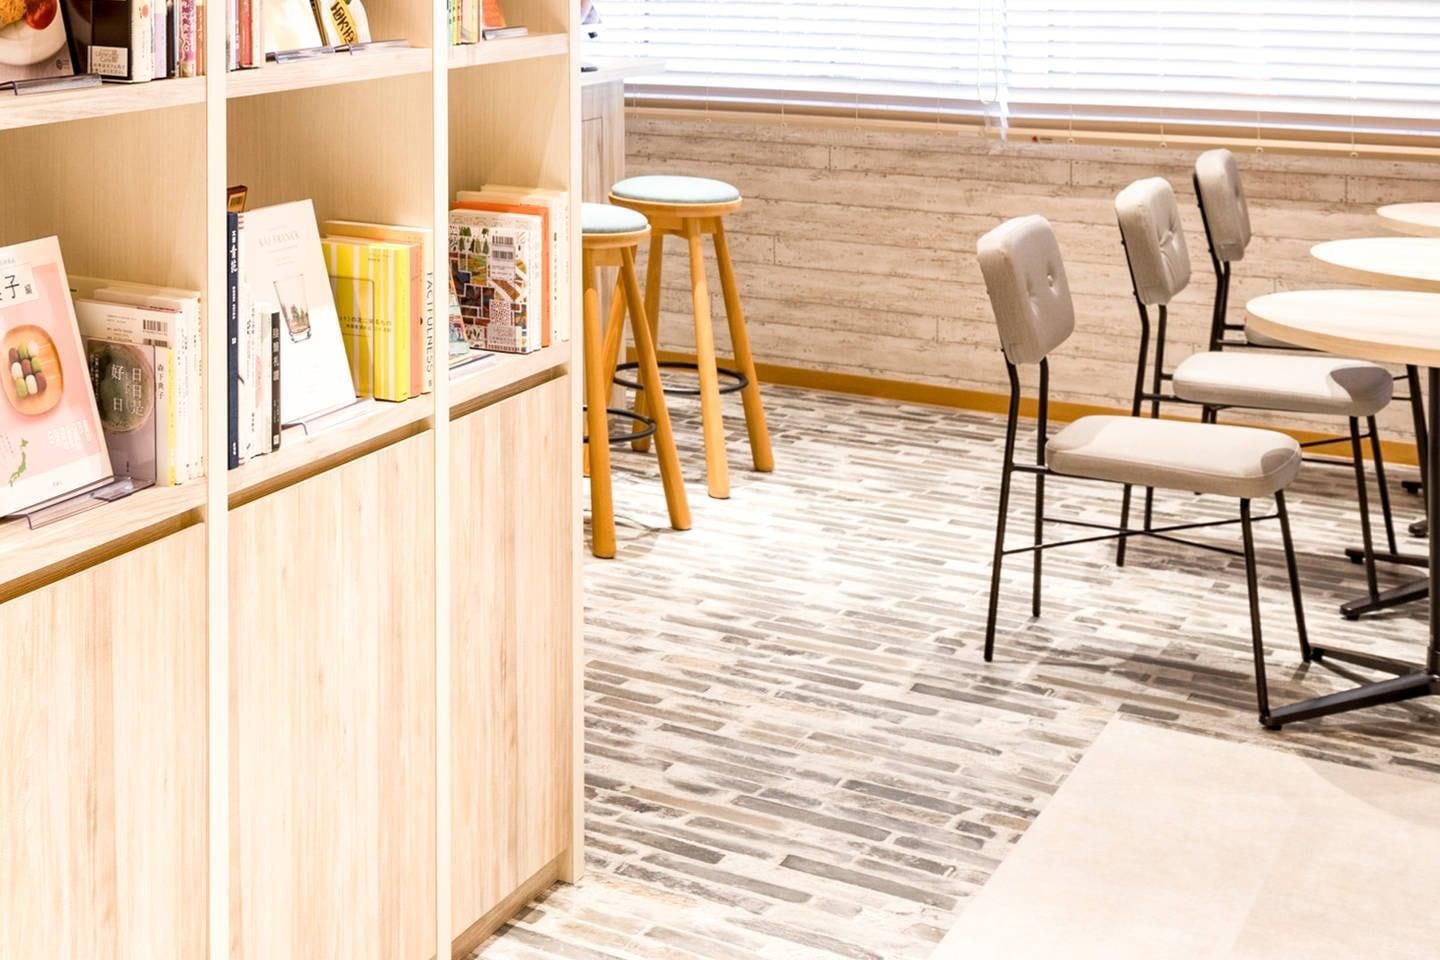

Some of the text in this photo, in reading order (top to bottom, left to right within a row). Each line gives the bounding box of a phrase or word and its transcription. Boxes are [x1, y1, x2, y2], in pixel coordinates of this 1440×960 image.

[111, 363, 125, 413] 好日
[130, 367, 145, 417] 日日是
